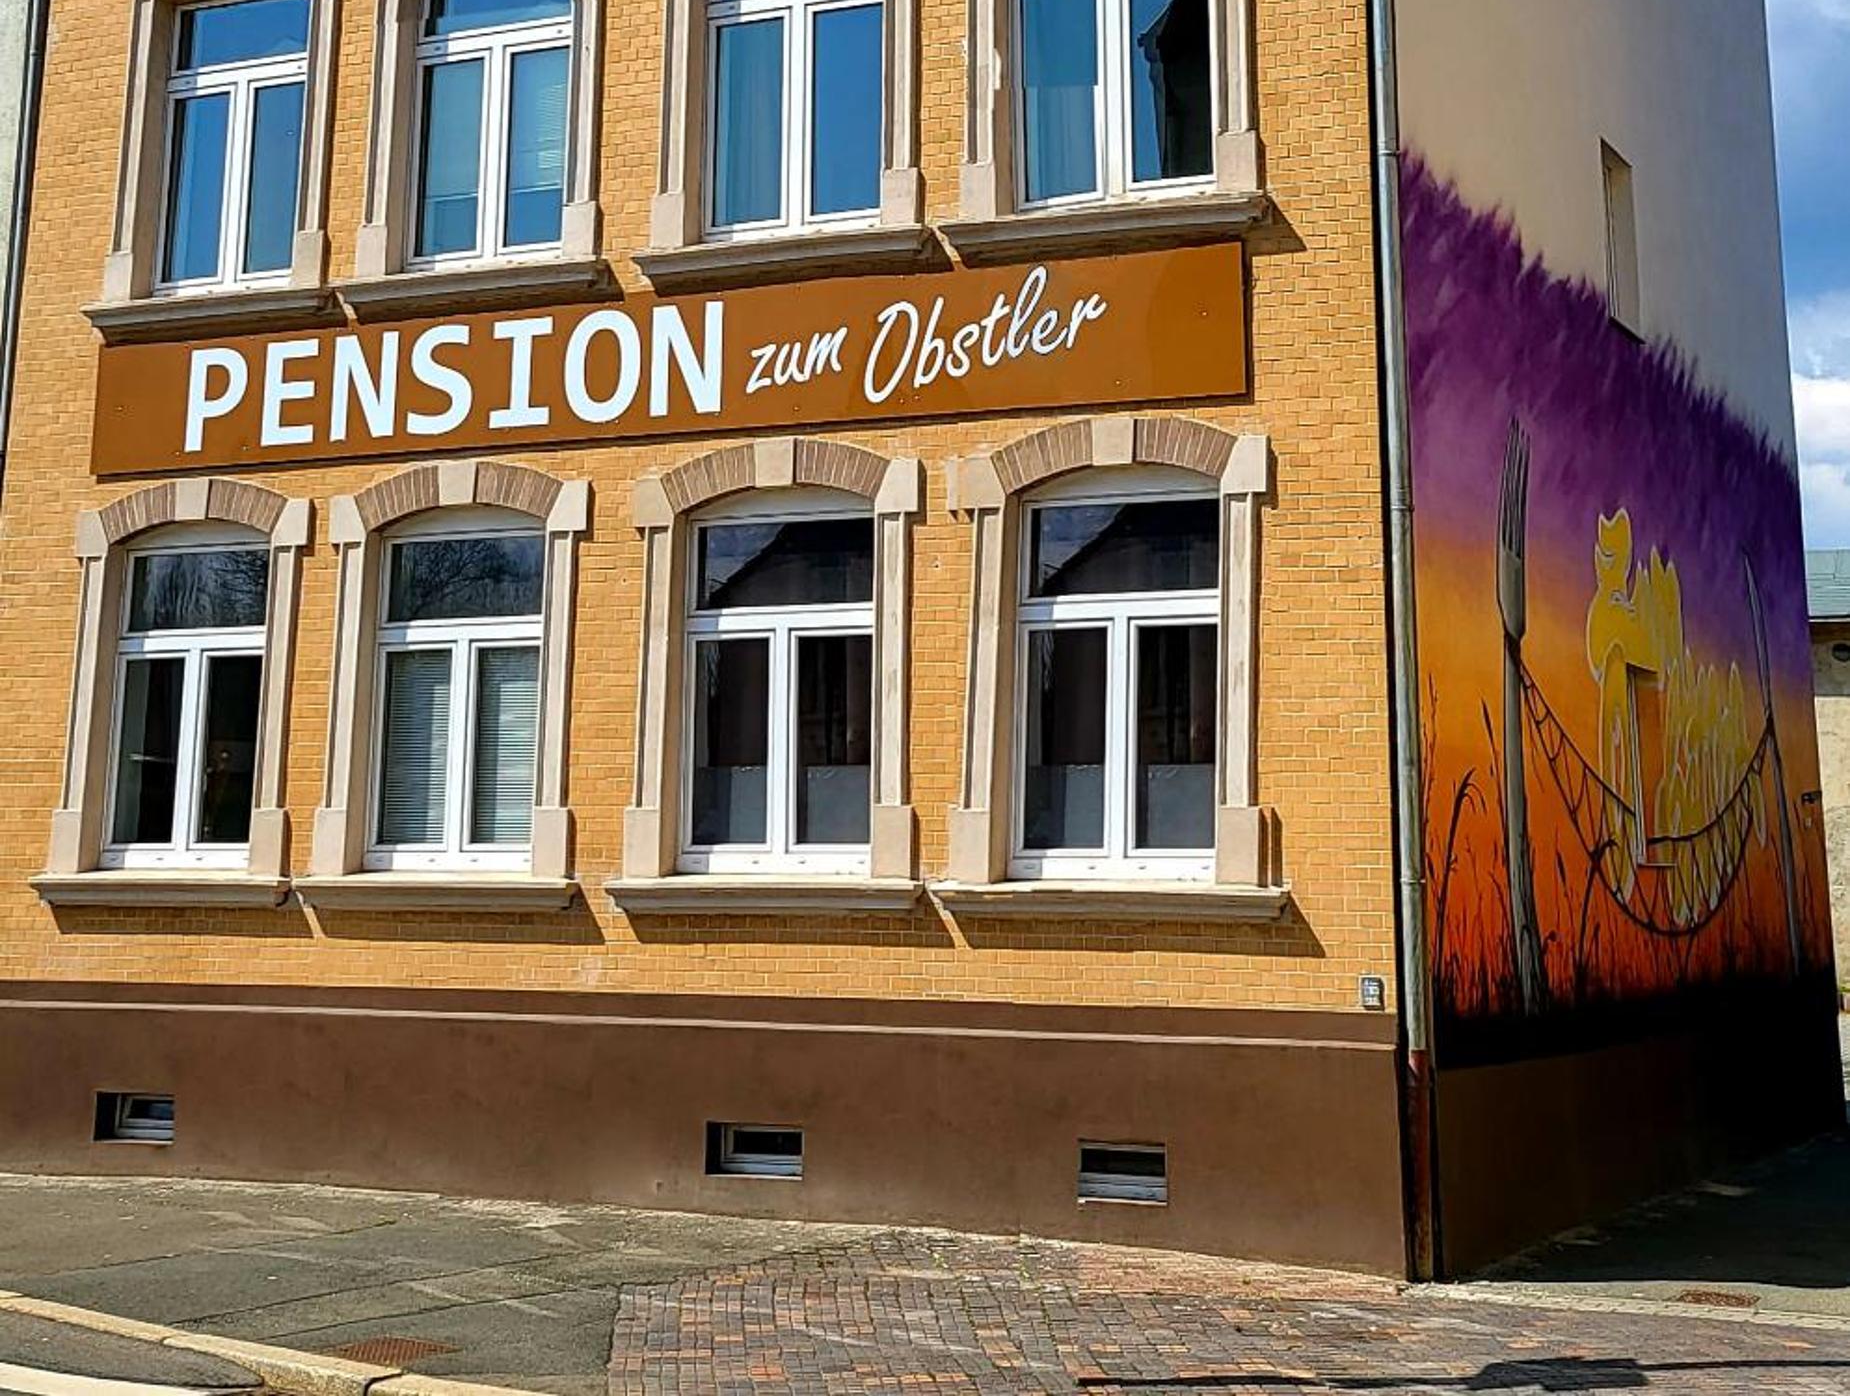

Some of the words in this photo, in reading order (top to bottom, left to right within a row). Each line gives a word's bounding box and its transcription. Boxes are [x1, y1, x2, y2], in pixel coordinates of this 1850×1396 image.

[185, 300, 724, 453] PENSION
[746, 327, 848, 395] zum
[863, 265, 1107, 403] Obstler
